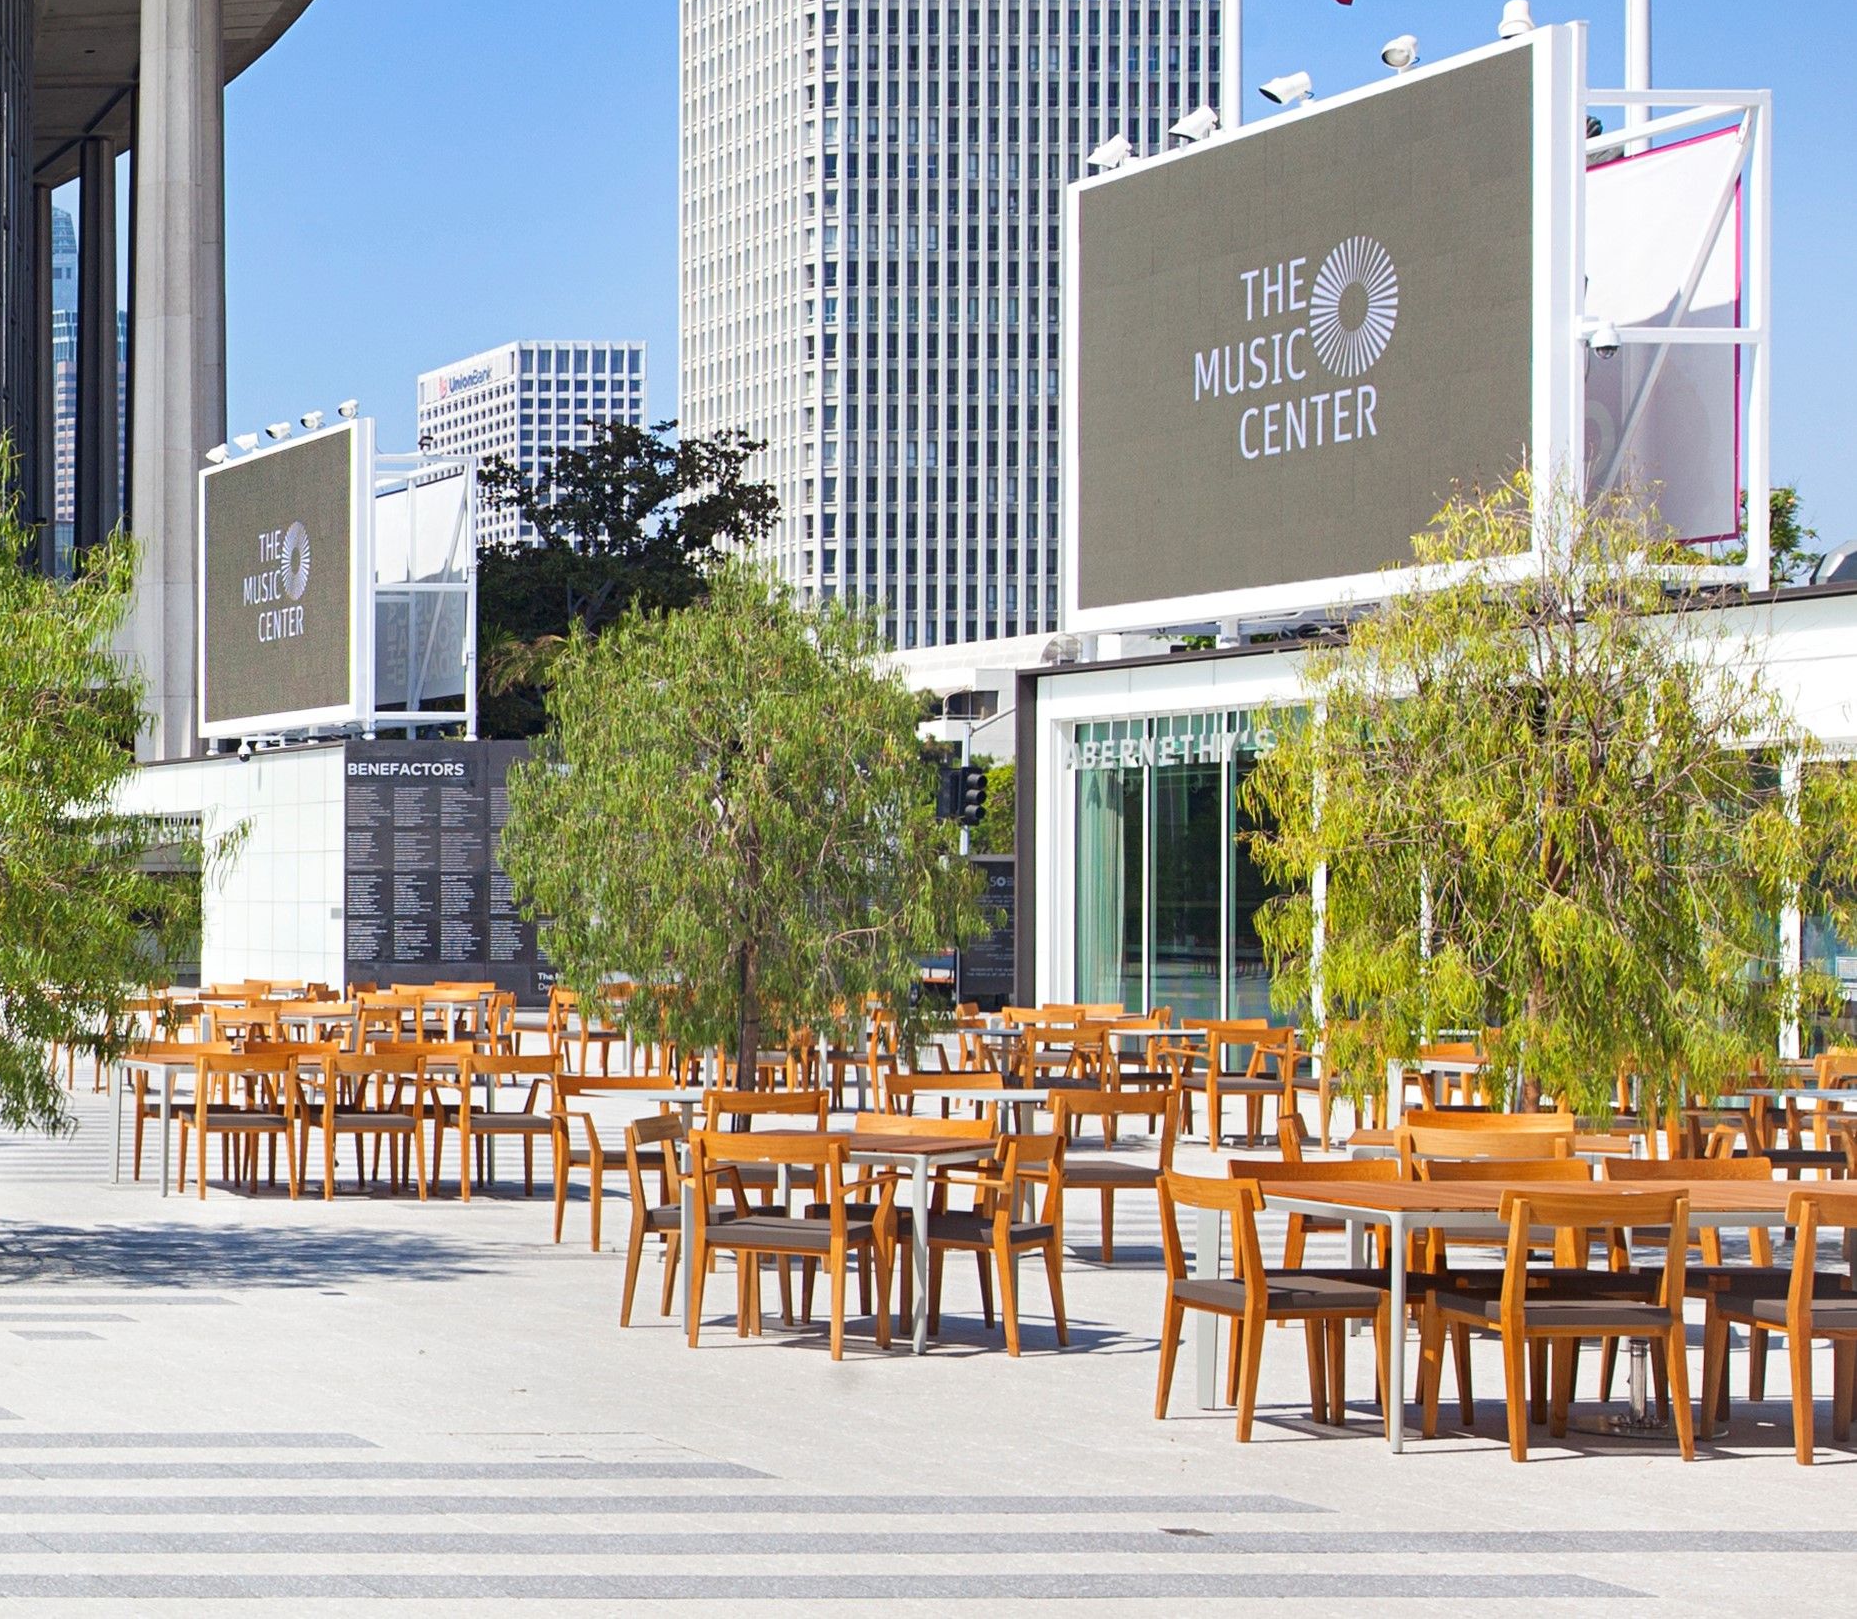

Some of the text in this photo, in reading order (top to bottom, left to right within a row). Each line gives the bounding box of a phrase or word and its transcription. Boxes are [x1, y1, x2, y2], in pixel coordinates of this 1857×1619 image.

[1240, 257, 1307, 322] THE
[1194, 327, 1307, 402] MUSIC
[1239, 384, 1377, 460] CENTER
[259, 530, 282, 563] THE
[243, 569, 282, 607] MUSIC
[258, 605, 304, 643] CENTER
[347, 762, 465, 776] BENEFACTORS
[1066, 728, 1278, 771] ABERNETHY'S
